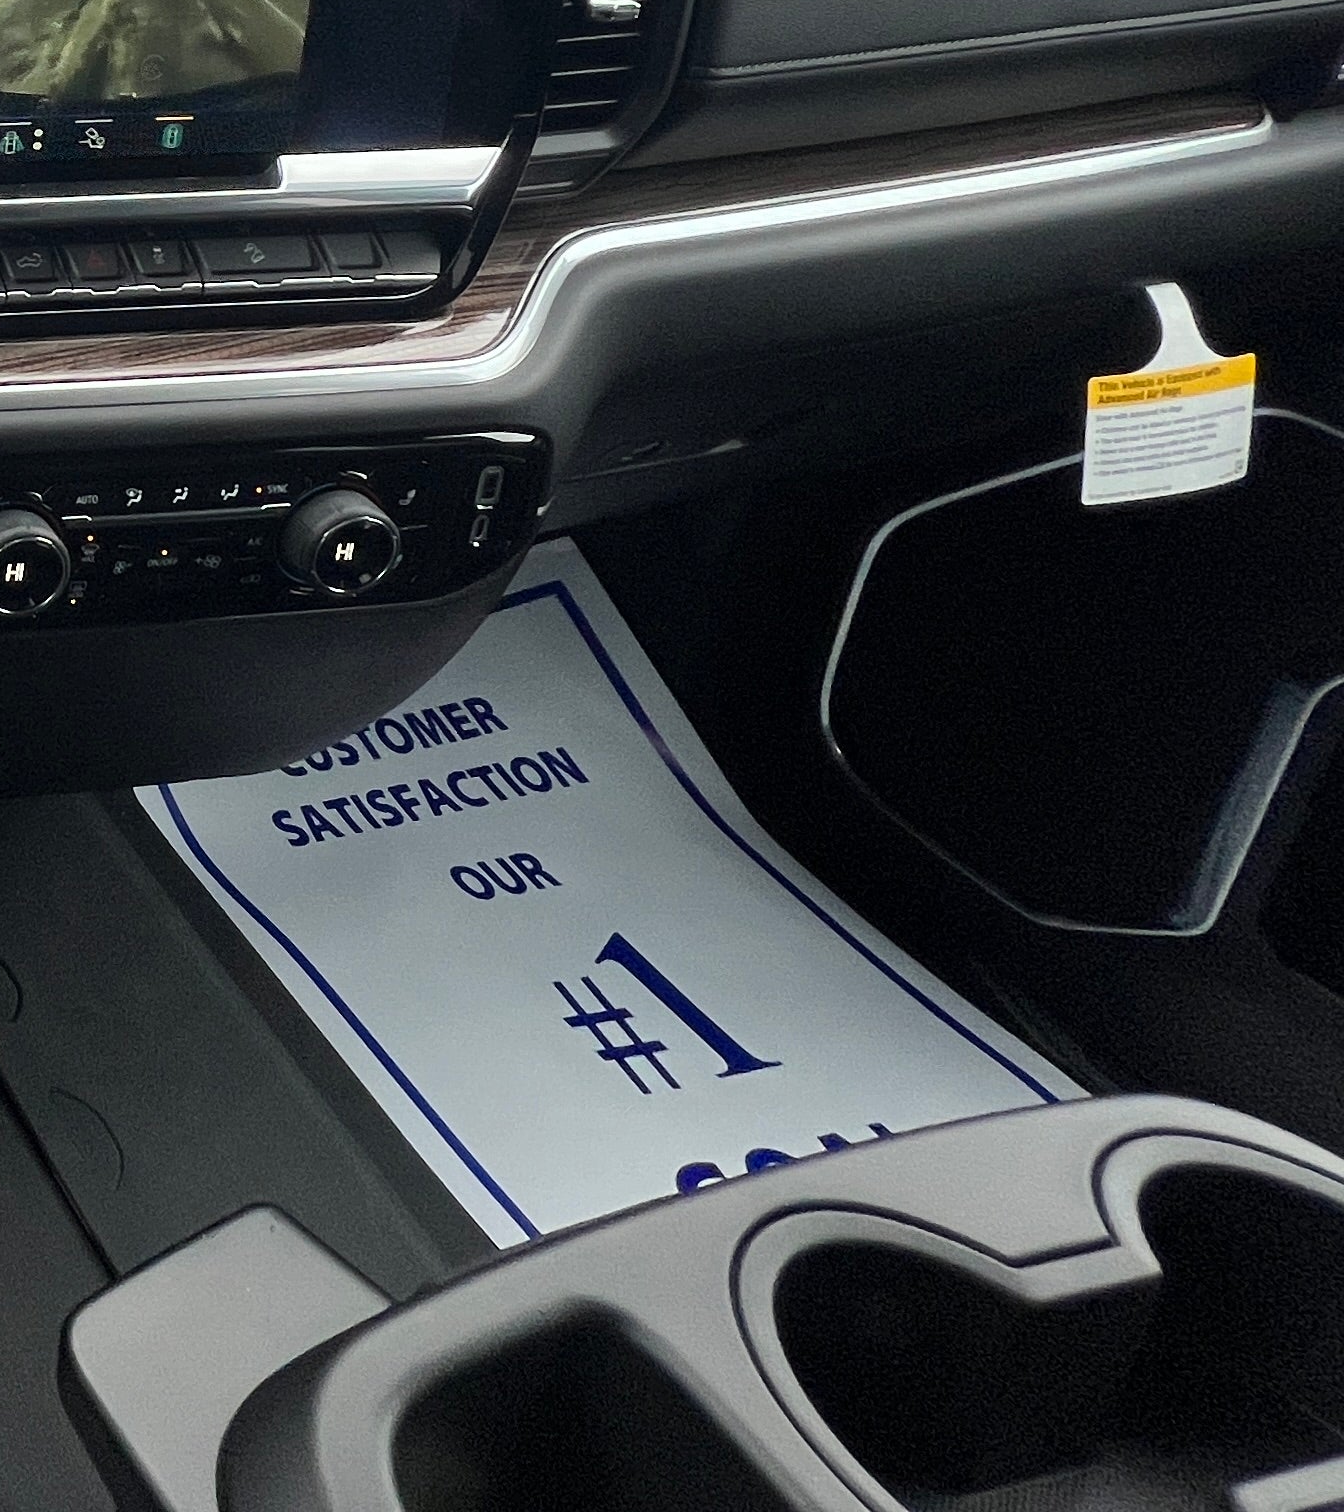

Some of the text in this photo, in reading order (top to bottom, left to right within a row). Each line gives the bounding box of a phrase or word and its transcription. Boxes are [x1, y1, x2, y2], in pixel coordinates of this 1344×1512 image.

[76, 494, 98, 504] AUTO
[267, 484, 288, 494] SYNC
[335, 542, 354, 561] HI
[5, 562, 25, 582] HI
[272, 747, 590, 847] SATISFACTION
[450, 853, 562, 900] OUR
[552, 932, 783, 1095] #1
